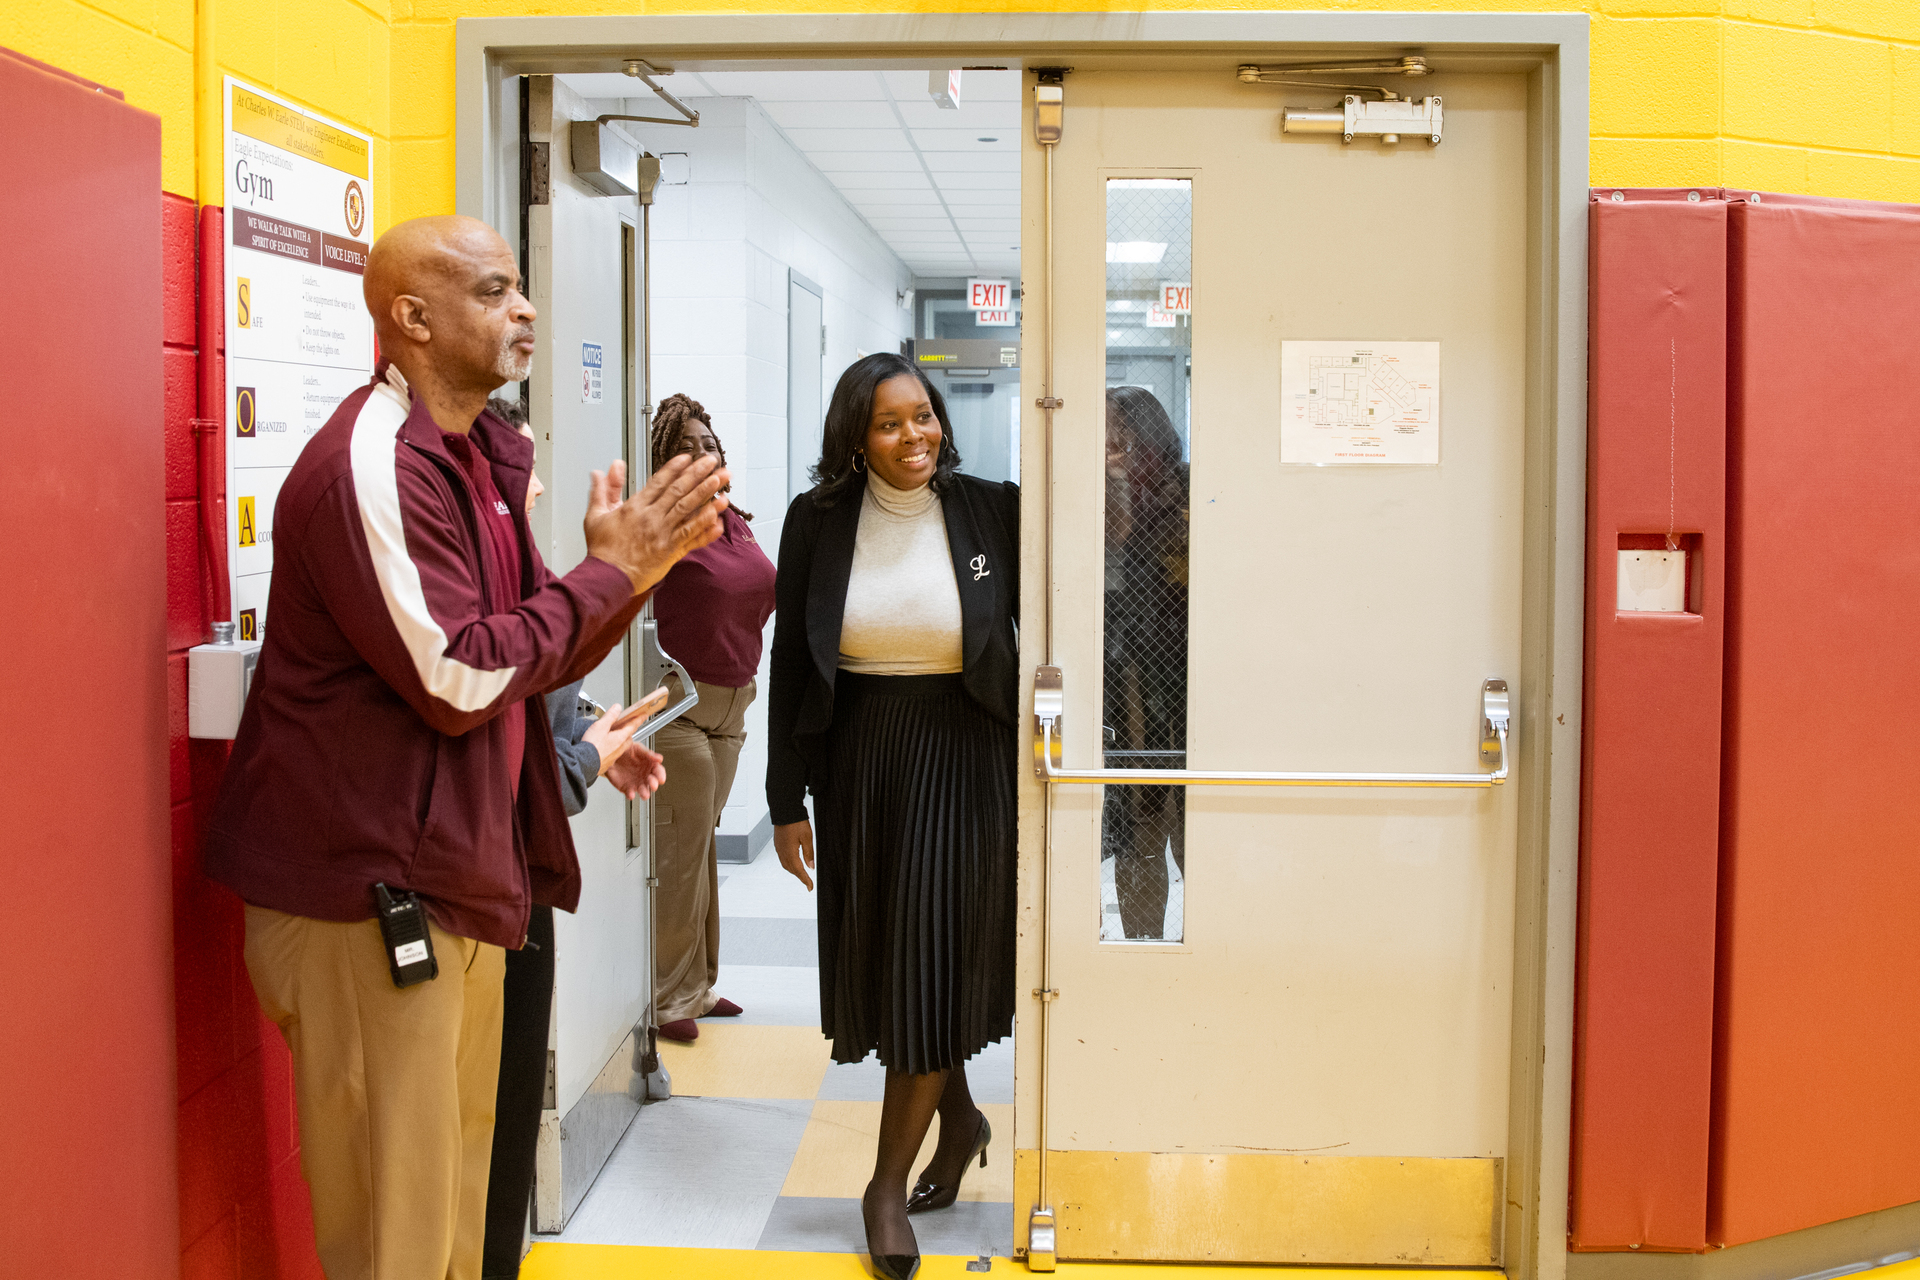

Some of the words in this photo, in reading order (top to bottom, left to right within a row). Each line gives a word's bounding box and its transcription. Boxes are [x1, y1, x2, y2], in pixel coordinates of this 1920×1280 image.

[236, 94, 244, 107] At
[245, 97, 267, 117] Charles
[267, 106, 275, 119] W.
[276, 110, 289, 126] Earle
[290, 116, 305, 133] STEM
[306, 124, 314, 135] we
[314, 126, 336, 144] Engineer
[336, 135, 360, 154] Excellence
[361, 145, 366, 157] in
[234, 138, 252, 161] Eagle
[254, 144, 294, 171] Expectations:
[294, 137, 325, 159] stakeholders.
[235, 159, 274, 206] Gym
[247, 216, 257, 229] WE
[258, 218, 274, 234] WALK
[274, 223, 279, 234] &
[279, 224, 292, 238] TALK
[293, 227, 307, 242] WITH
[306, 233, 312, 243] A
[252, 235, 269, 249] SPIRIT
[269, 239, 277, 251] OF
[277, 241, 309, 259] EXCELLENCE
[325, 244, 343, 260] VOICE
[344, 250, 363, 266] LEVEL:
[305, 292, 313, 303] Use
[313, 295, 334, 307] equipment
[973, 284, 1006, 306] EXIT
[1165, 287, 1191, 310] EXI
[305, 325, 312, 336] Do
[312, 328, 320, 337] not
[305, 342, 317, 355] Keep
[323, 344, 333, 357] lights
[583, 346, 601, 364] NOTICE
